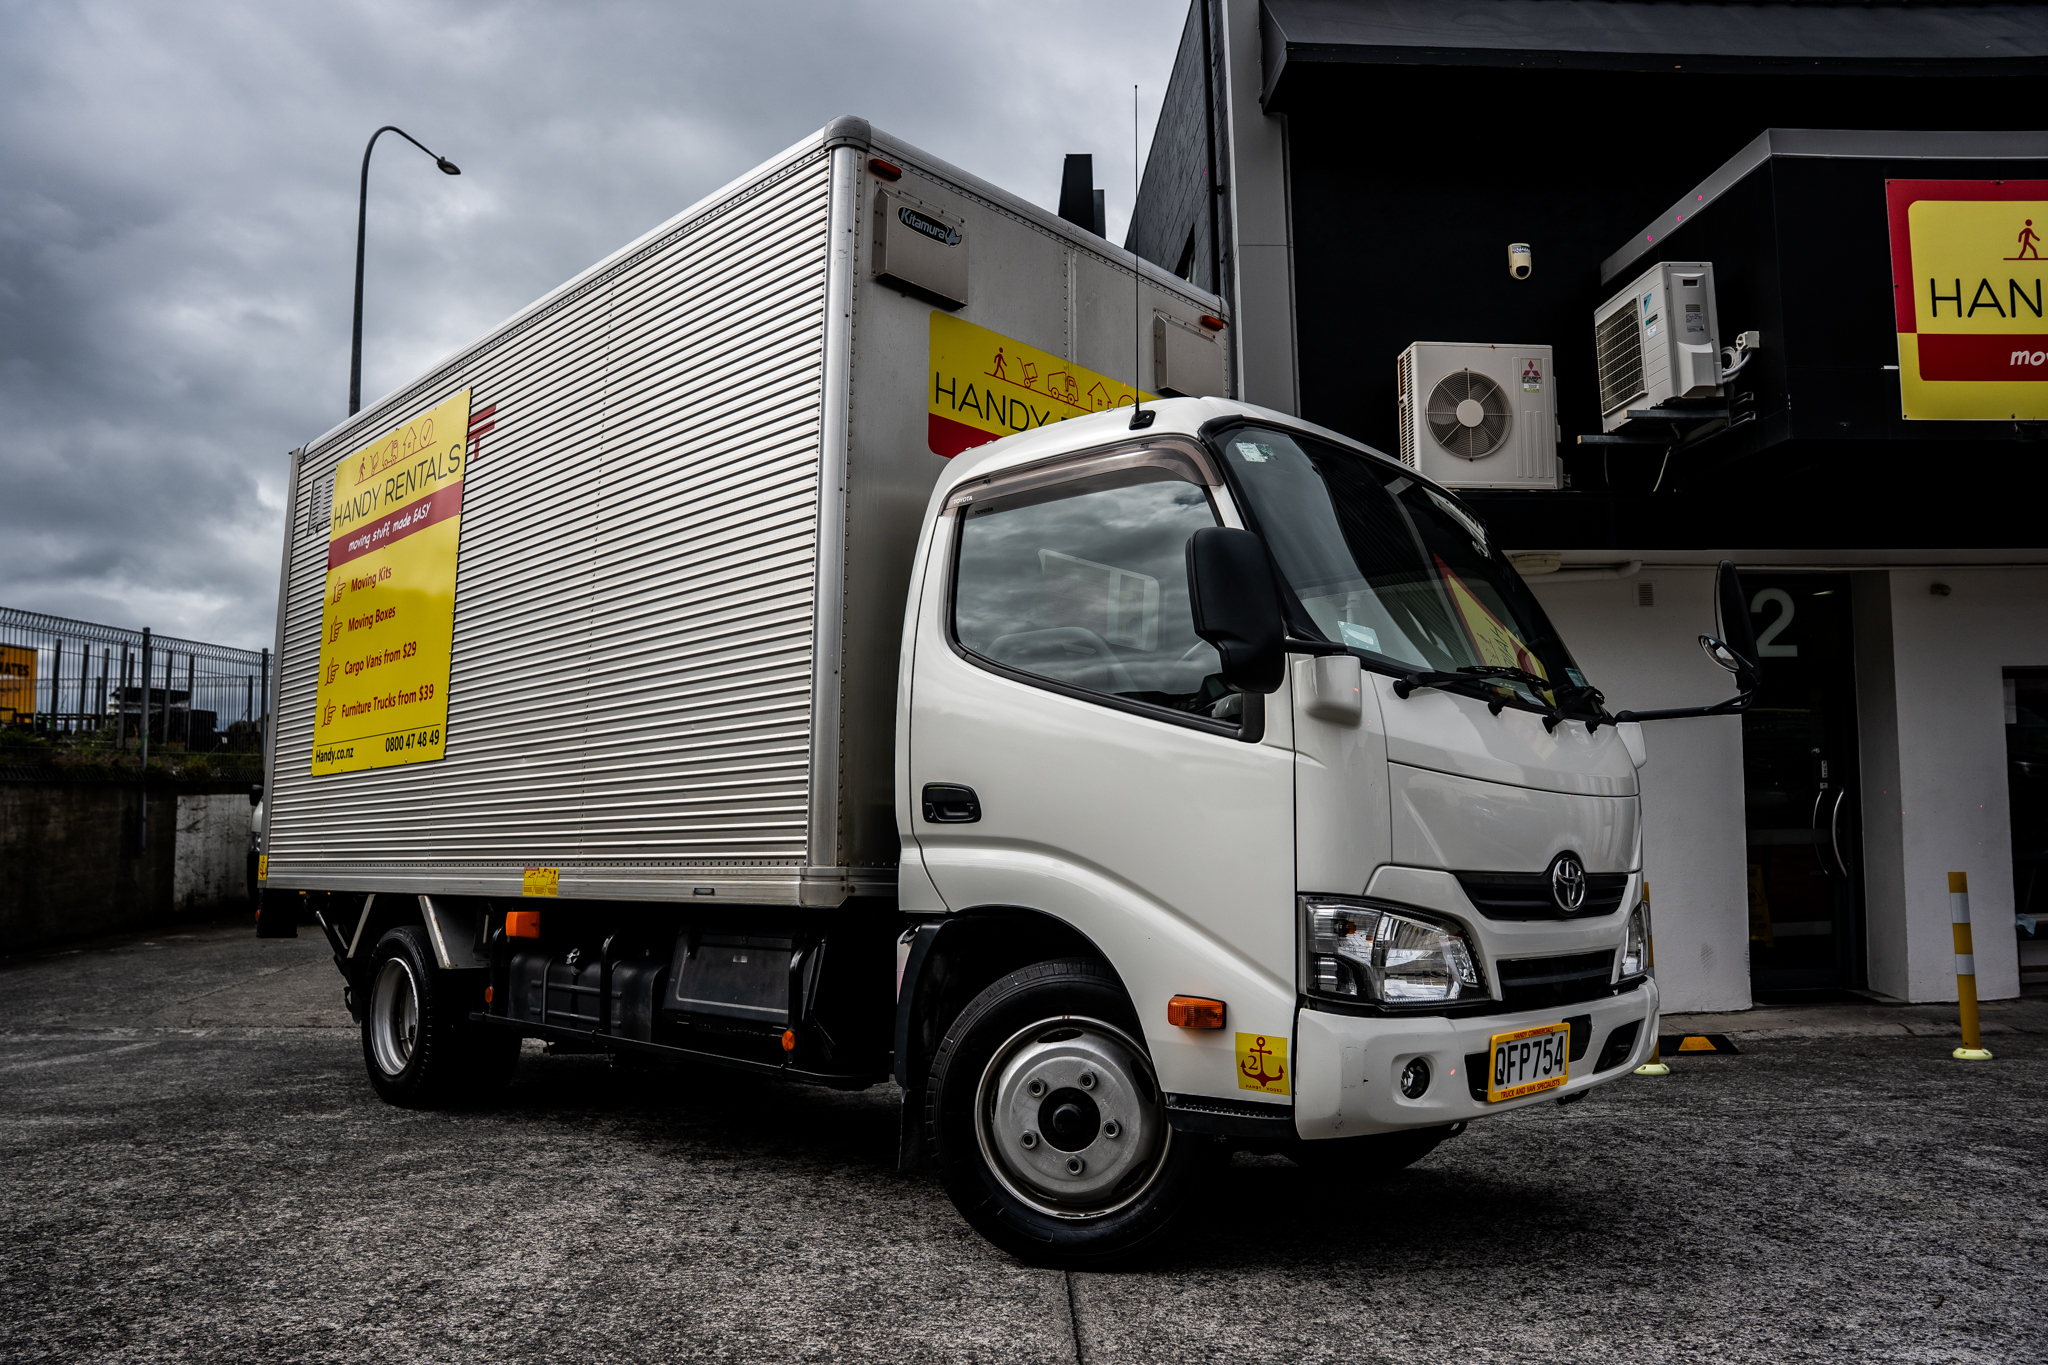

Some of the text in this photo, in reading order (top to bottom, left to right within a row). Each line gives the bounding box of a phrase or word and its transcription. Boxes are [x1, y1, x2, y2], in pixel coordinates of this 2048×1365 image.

[900, 207, 946, 239] Kitamura
[2009, 350, 2048, 367] mo
[935, 371, 1050, 432] HANDY
[333, 443, 461, 531] HANDY RENTALS
[953, 495, 973, 504] TOYOTA
[348, 533, 371, 552] moving
[392, 512, 411, 532] made
[412, 501, 431, 524] EASY
[350, 566, 392, 592] Moving Kits
[347, 606, 396, 632] Moving Boxes
[1750, 587, 1798, 657] 2
[344, 641, 417, 676] Cargo Vans from $29
[341, 683, 434, 718] Furniture Trucks from $39
[385, 729, 440, 752] 0800 47 48 49
[315, 747, 354, 765] Handy.co.nz
[1514, 1026, 1554, 1040] HANDY COMMERCIALS
[1247, 1055, 1258, 1071] 2
[1494, 1035, 1564, 1086] QFP754
[1500, 1079, 1561, 1099] TRUCK AND VAN SPECIALISTS
